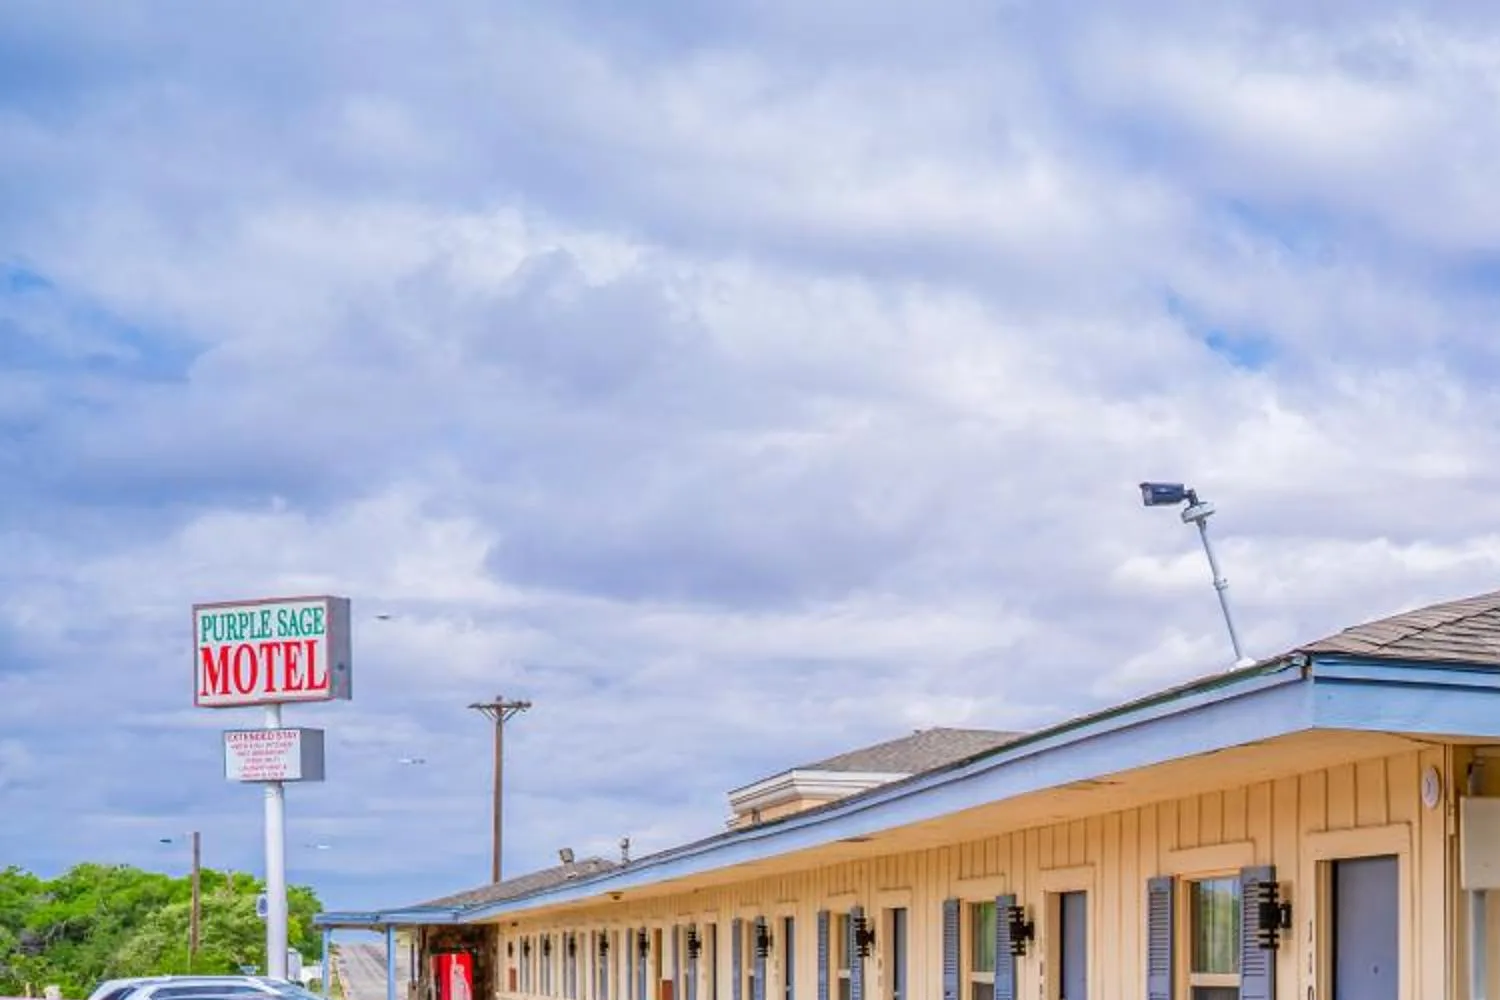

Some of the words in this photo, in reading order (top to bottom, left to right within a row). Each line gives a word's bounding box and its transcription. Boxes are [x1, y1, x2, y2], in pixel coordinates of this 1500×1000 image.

[200, 609, 271, 643] PURPLE
[277, 607, 325, 637] SAGE
[199, 639, 329, 696] MOTEL
[277, 730, 298, 740] STAY
